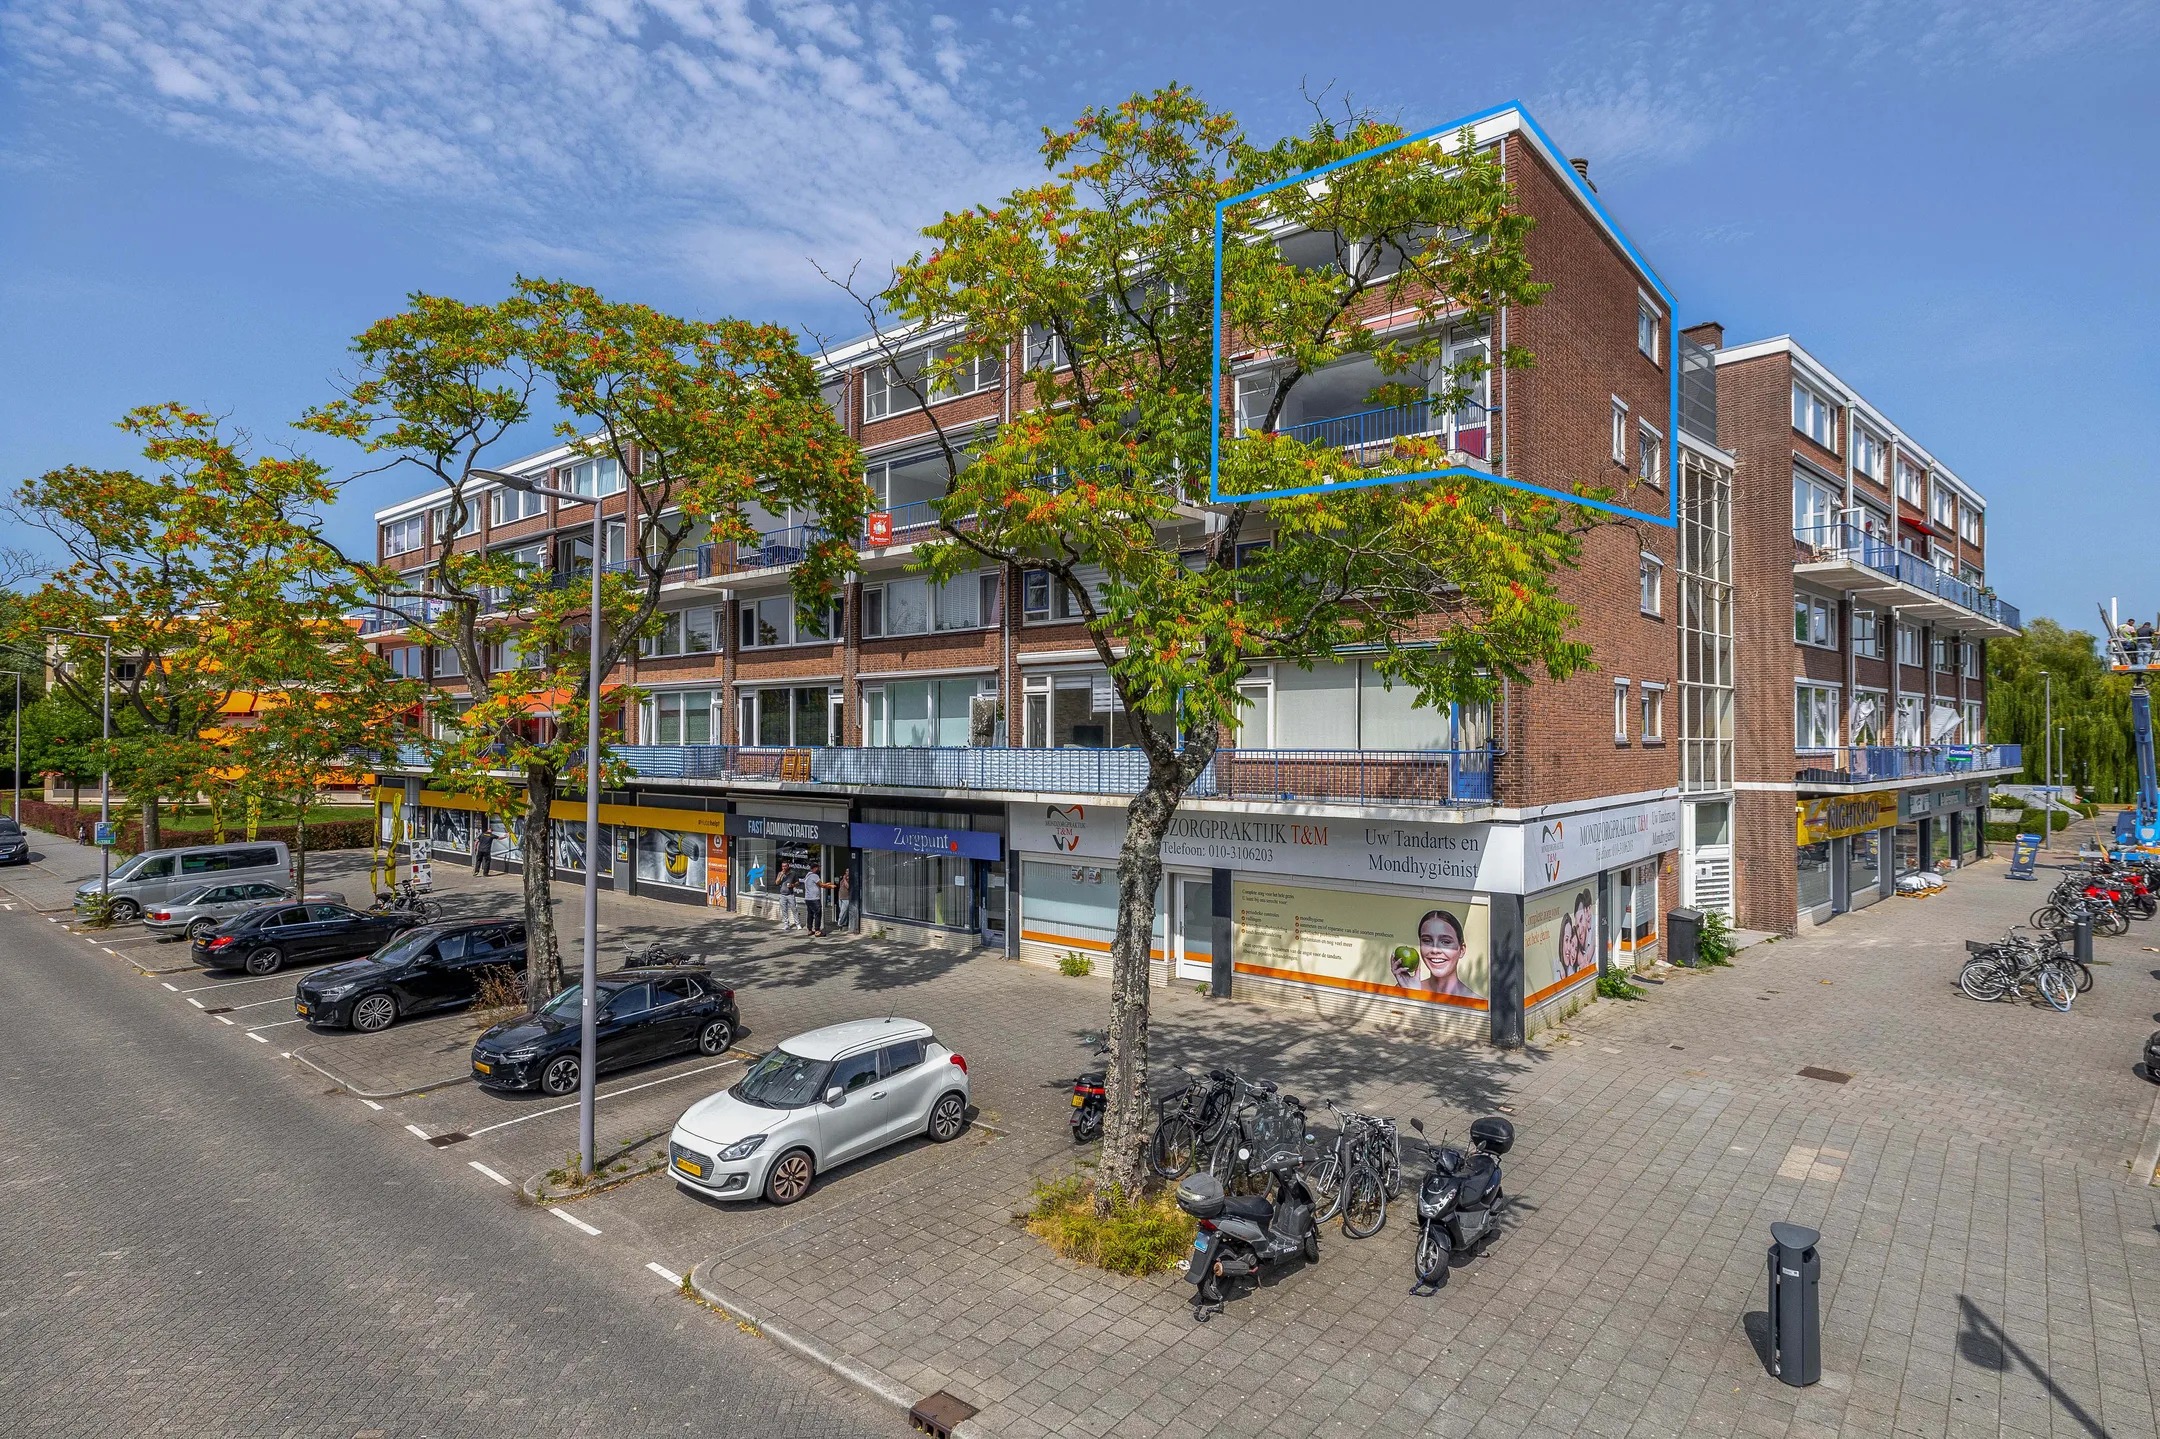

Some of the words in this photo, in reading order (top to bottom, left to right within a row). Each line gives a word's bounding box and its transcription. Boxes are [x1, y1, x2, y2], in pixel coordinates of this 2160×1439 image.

[1827, 800, 1879, 831] NIGHTSHOP
[748, 820, 763, 834] FAST
[765, 821, 819, 839] ADMINISTRATIES
[894, 827, 949, 851] Zorgpunt
[1056, 828, 1073, 836] T&M
[1291, 824, 1328, 846] T&M
[1365, 828, 1389, 846] Uw
[1394, 830, 1456, 850] Tandarts
[1461, 838, 1479, 851] en
[1163, 841, 1206, 857] Telefoon:
[1208, 844, 1273, 862] 010-3106203
[1368, 853, 1478, 879] Mondhygiënist
